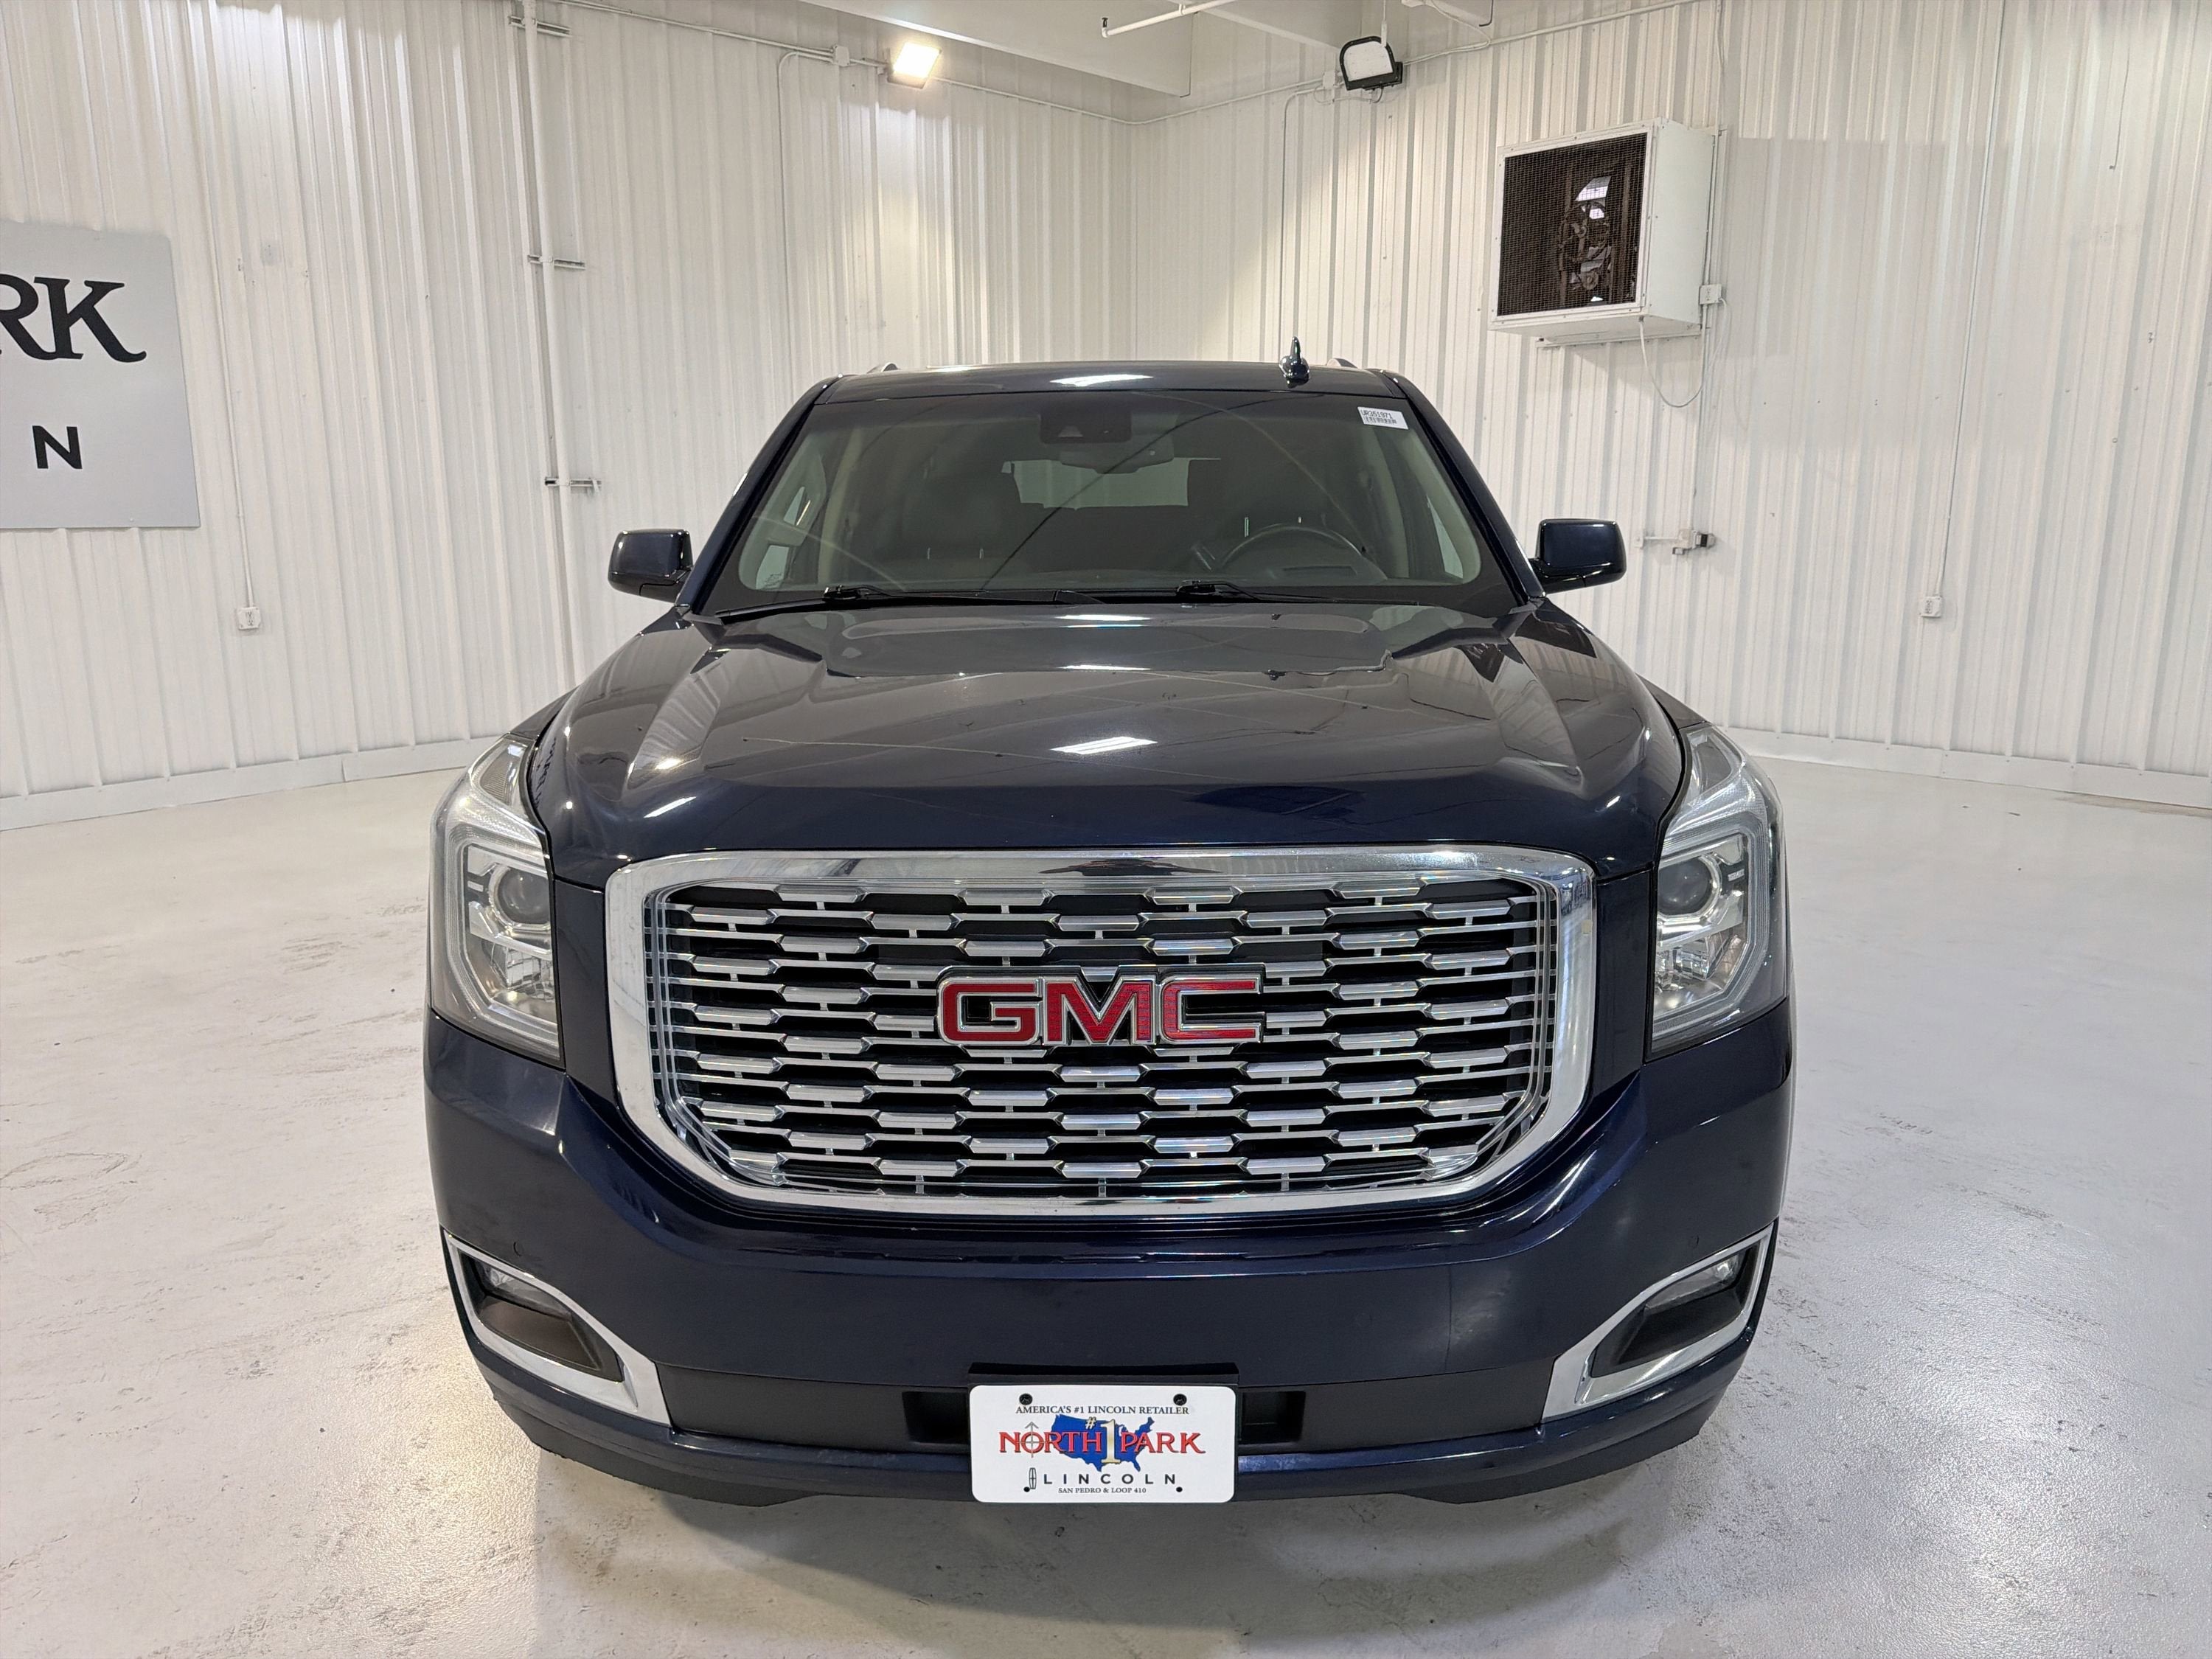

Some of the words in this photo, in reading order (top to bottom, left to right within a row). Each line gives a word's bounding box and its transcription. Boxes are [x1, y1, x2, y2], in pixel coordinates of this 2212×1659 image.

[936, 971, 1264, 1046] GMC
[1015, 1405, 1071, 1414] AMERICA'S
[1074, 1405, 1085, 1414] #1
[1088, 1405, 1136, 1414] LINCOLN
[1138, 1406, 1189, 1414] RETAILER
[998, 1431, 1102, 1453] NORTH
[1121, 1432, 1206, 1454] PARK
[1043, 1473, 1176, 1485] LINCOLN
